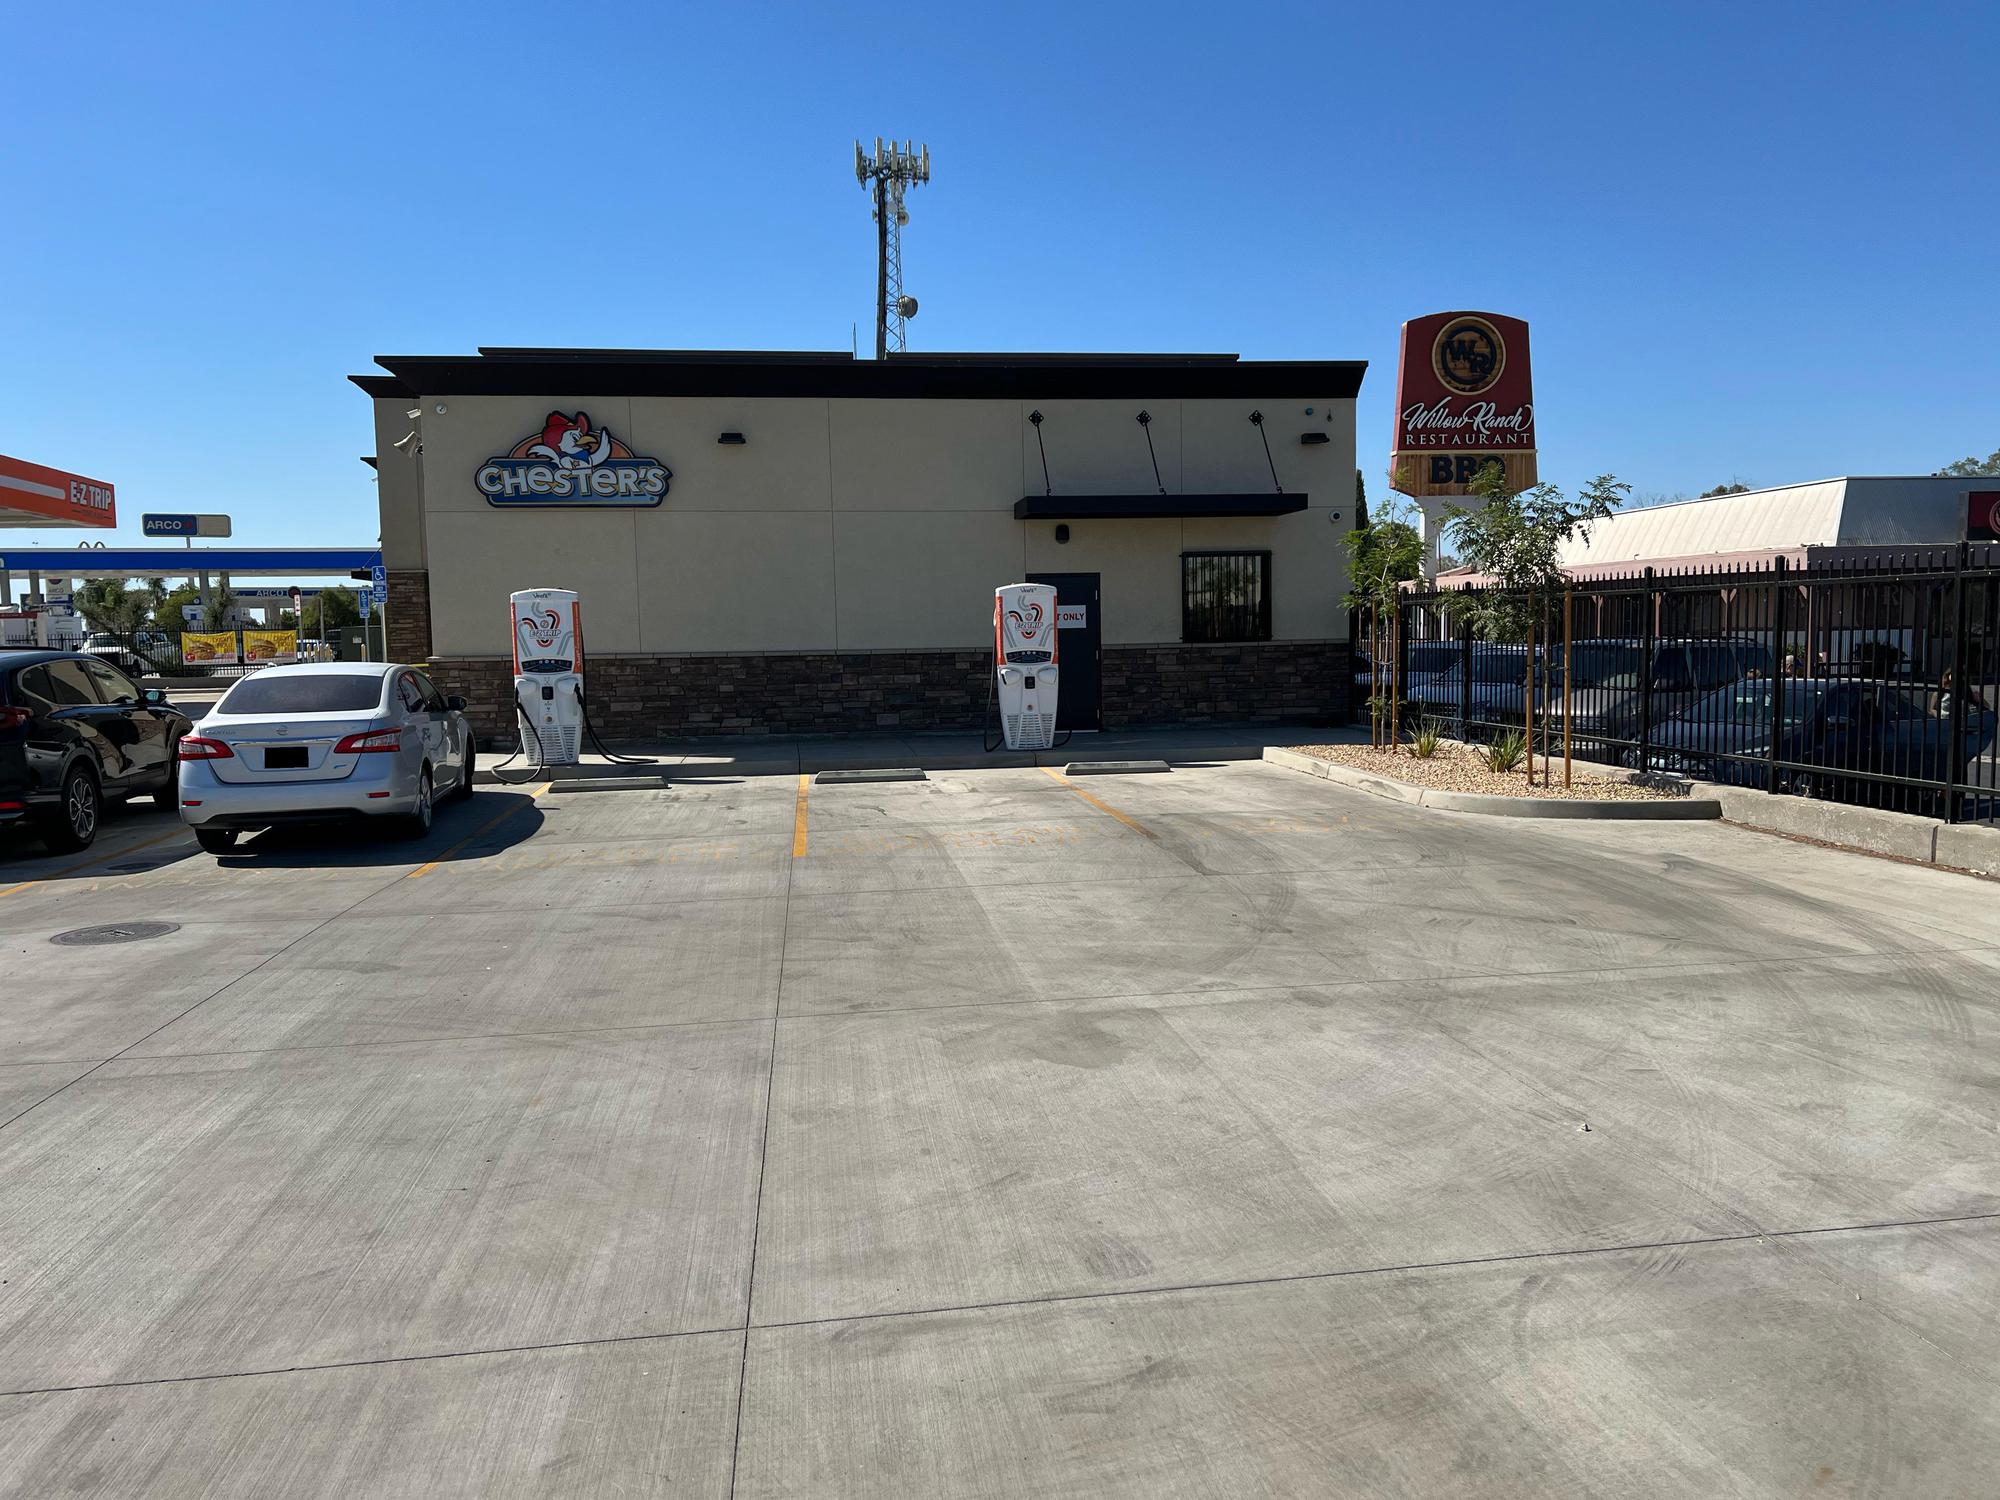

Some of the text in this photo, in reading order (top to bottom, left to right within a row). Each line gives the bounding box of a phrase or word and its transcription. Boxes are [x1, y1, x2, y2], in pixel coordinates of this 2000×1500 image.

[1402, 396, 1534, 435] Willow Ranch
[1406, 433, 1530, 445] RESTAURANT
[69, 479, 112, 511] E-Z TRIP
[146, 520, 182, 530] ARCO
[256, 588, 284, 598] ARCO
[1063, 612, 1084, 621] ONLY
